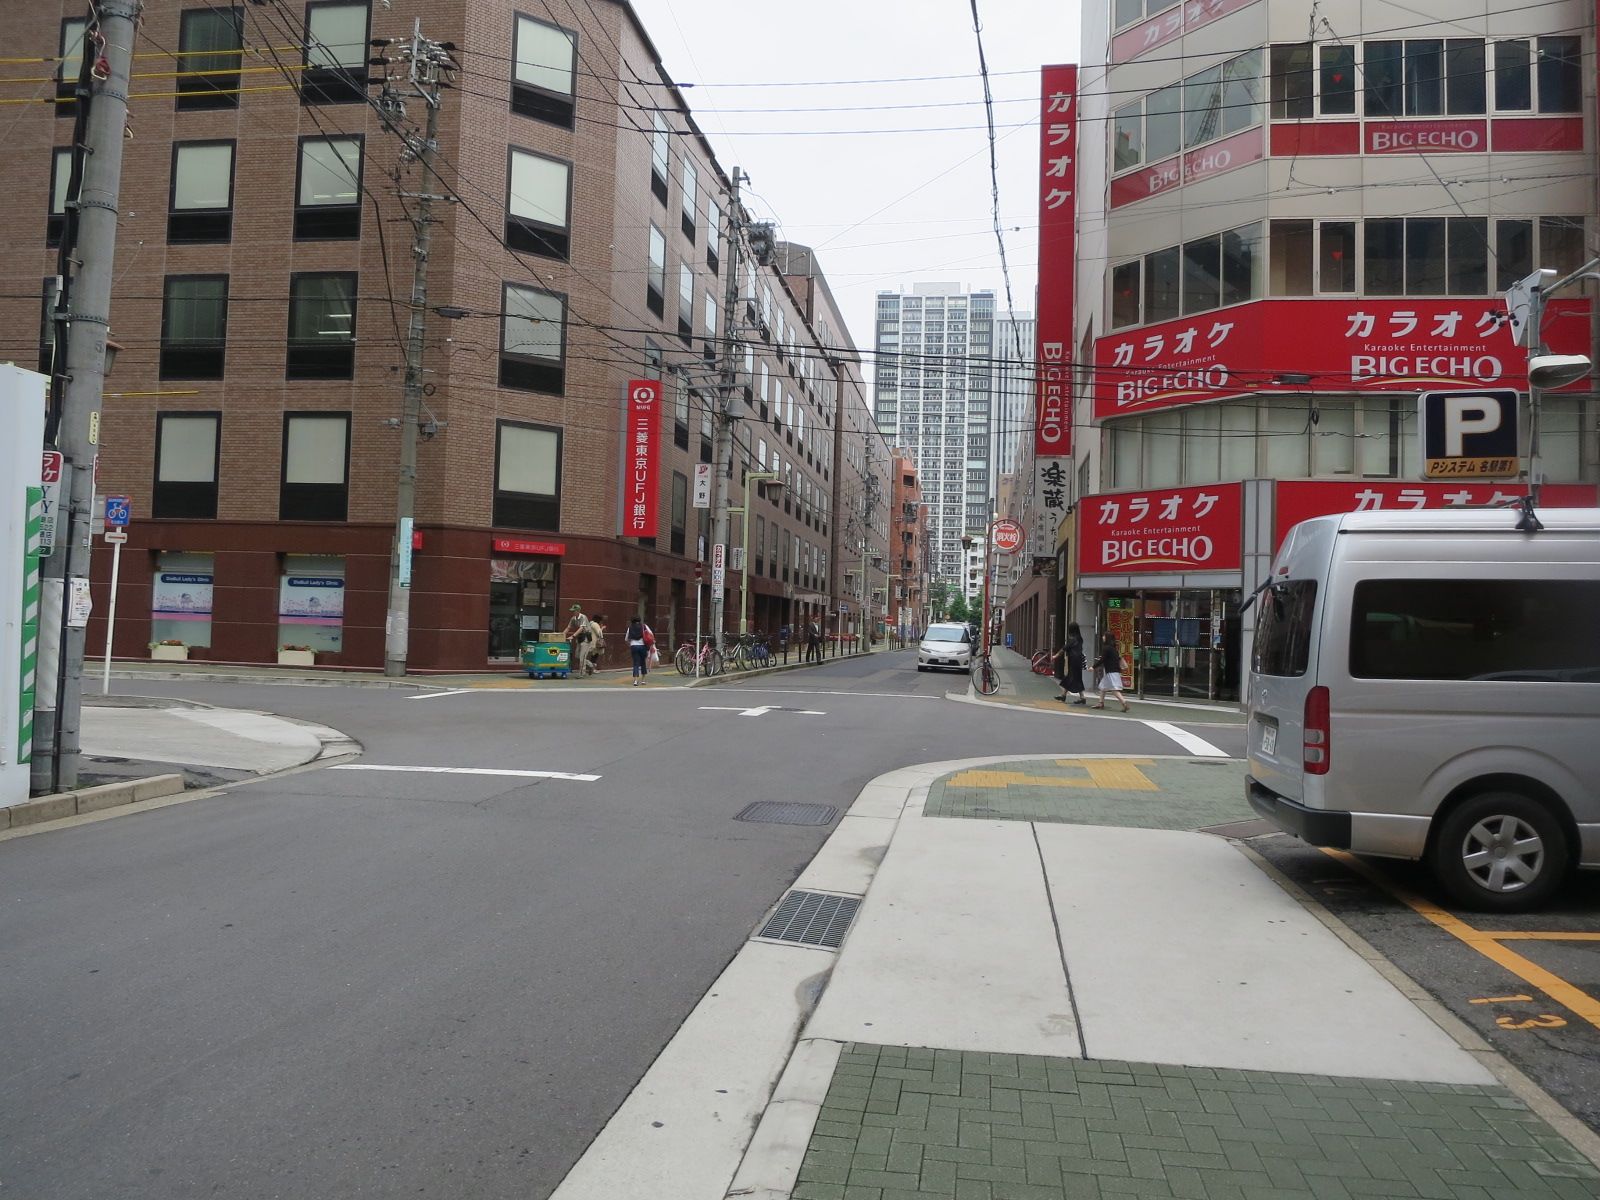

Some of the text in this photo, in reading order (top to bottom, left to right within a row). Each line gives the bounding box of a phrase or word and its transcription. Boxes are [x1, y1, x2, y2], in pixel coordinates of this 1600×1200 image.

[1045, 91, 1072, 210] カラオケ
[1372, 130, 1479, 151] BIG ECHO
[1150, 169, 1180, 193] BIG
[1344, 311, 1509, 338] カラオケ
[1112, 322, 1234, 367] カラオケ
[1364, 343, 1487, 352] Karaoke Entertainment
[1158, 354, 1216, 369] Entertainment
[1352, 355, 1503, 383] BIG ECHO
[1042, 342, 1063, 443] BIG ECHO
[1117, 364, 1229, 407] BIG ECHO
[1444, 396, 1502, 457] P
[633, 418, 649, 529] 三菱東京UFJ銀行
[1430, 461, 1475, 473] Pシステム
[1098, 493, 1219, 525] カラオケ
[1143, 525, 1201, 535] Entertainment
[1102, 535, 1213, 565] BIG ECHO
